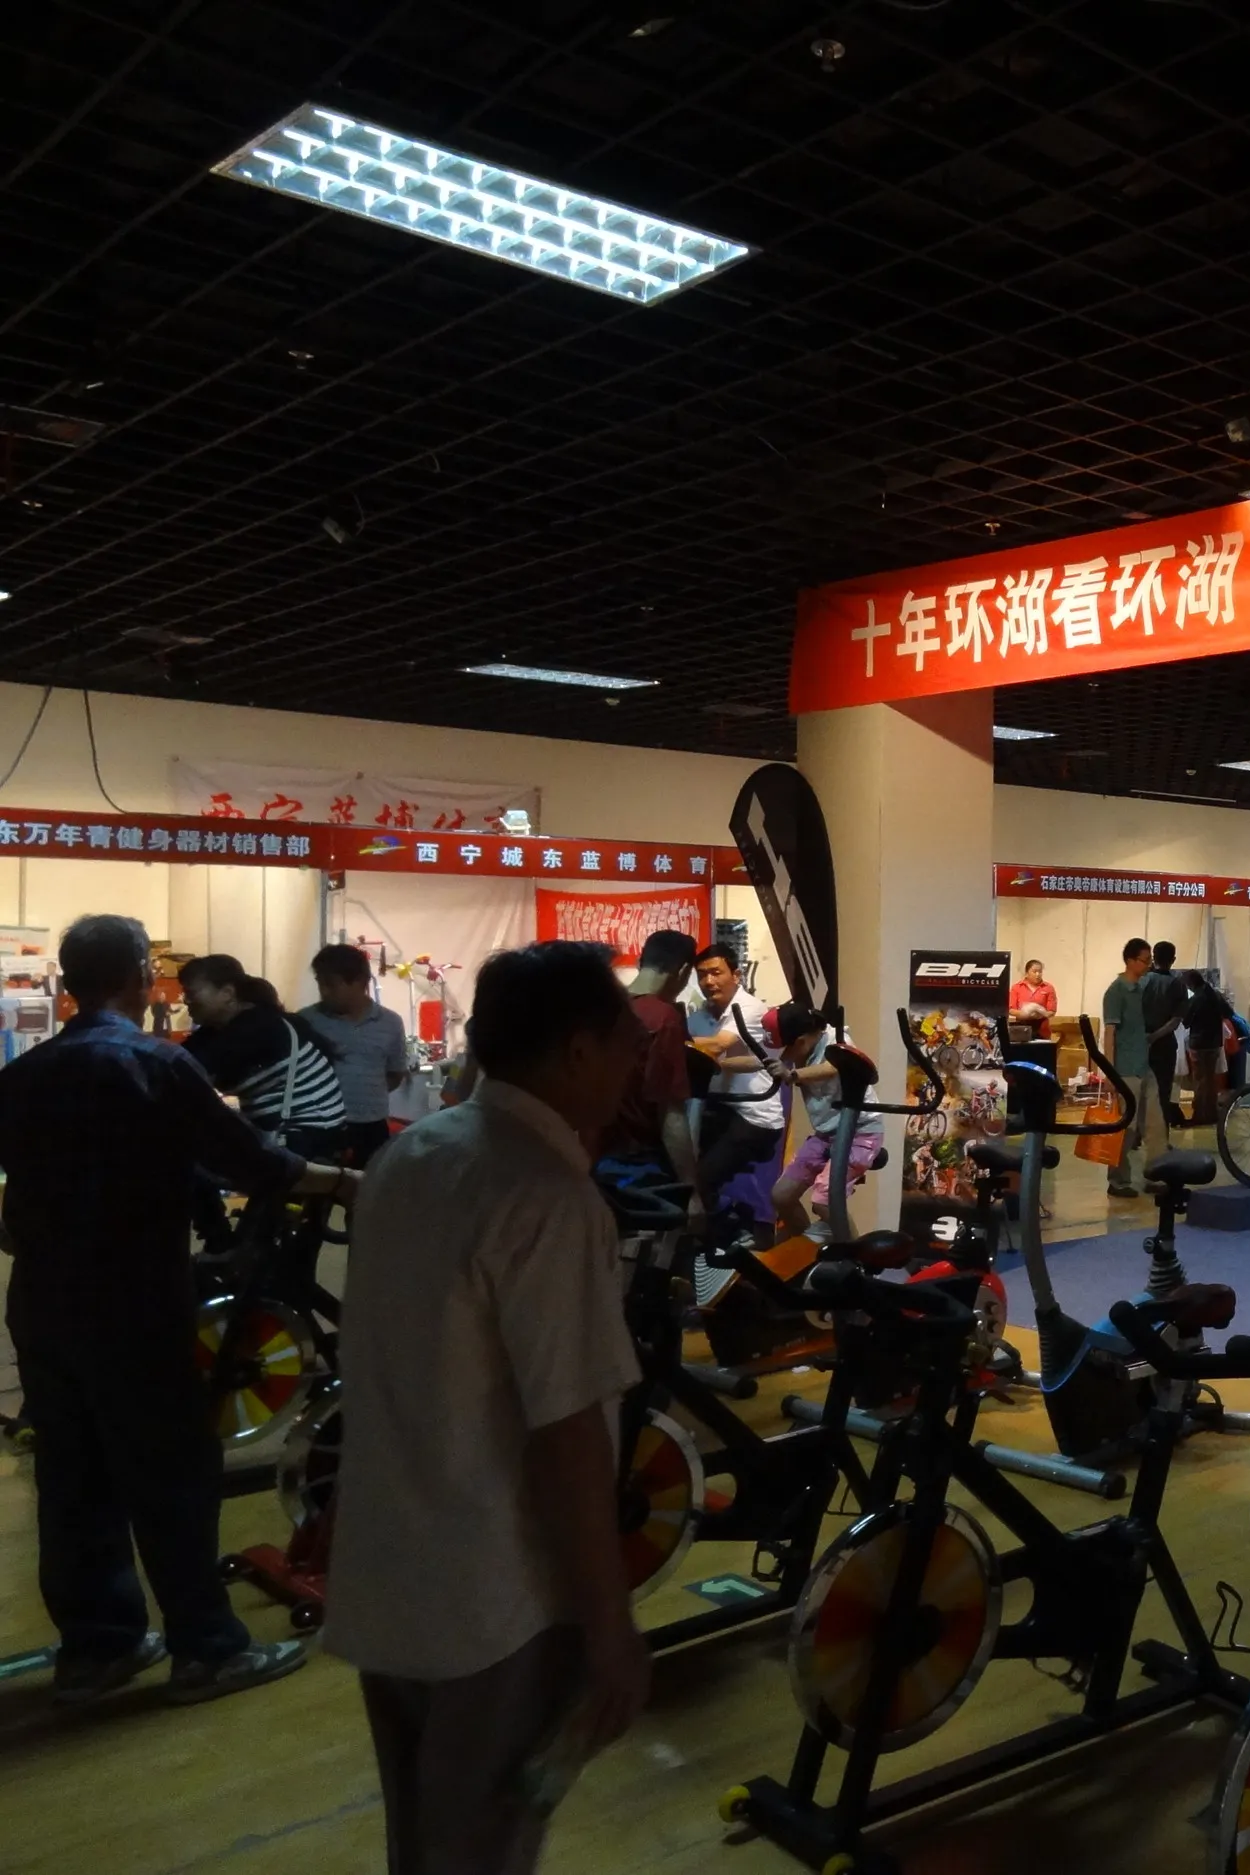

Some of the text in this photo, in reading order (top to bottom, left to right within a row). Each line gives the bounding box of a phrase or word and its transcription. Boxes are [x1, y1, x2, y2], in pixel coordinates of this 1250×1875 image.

[850, 531, 1239, 681] 十年环湖看环湖
[0, 818, 310, 858] 东万年青健身器材销售部
[416, 842, 708, 876] 西宁城东蓝博体育
[915, 962, 1007, 978] BH
